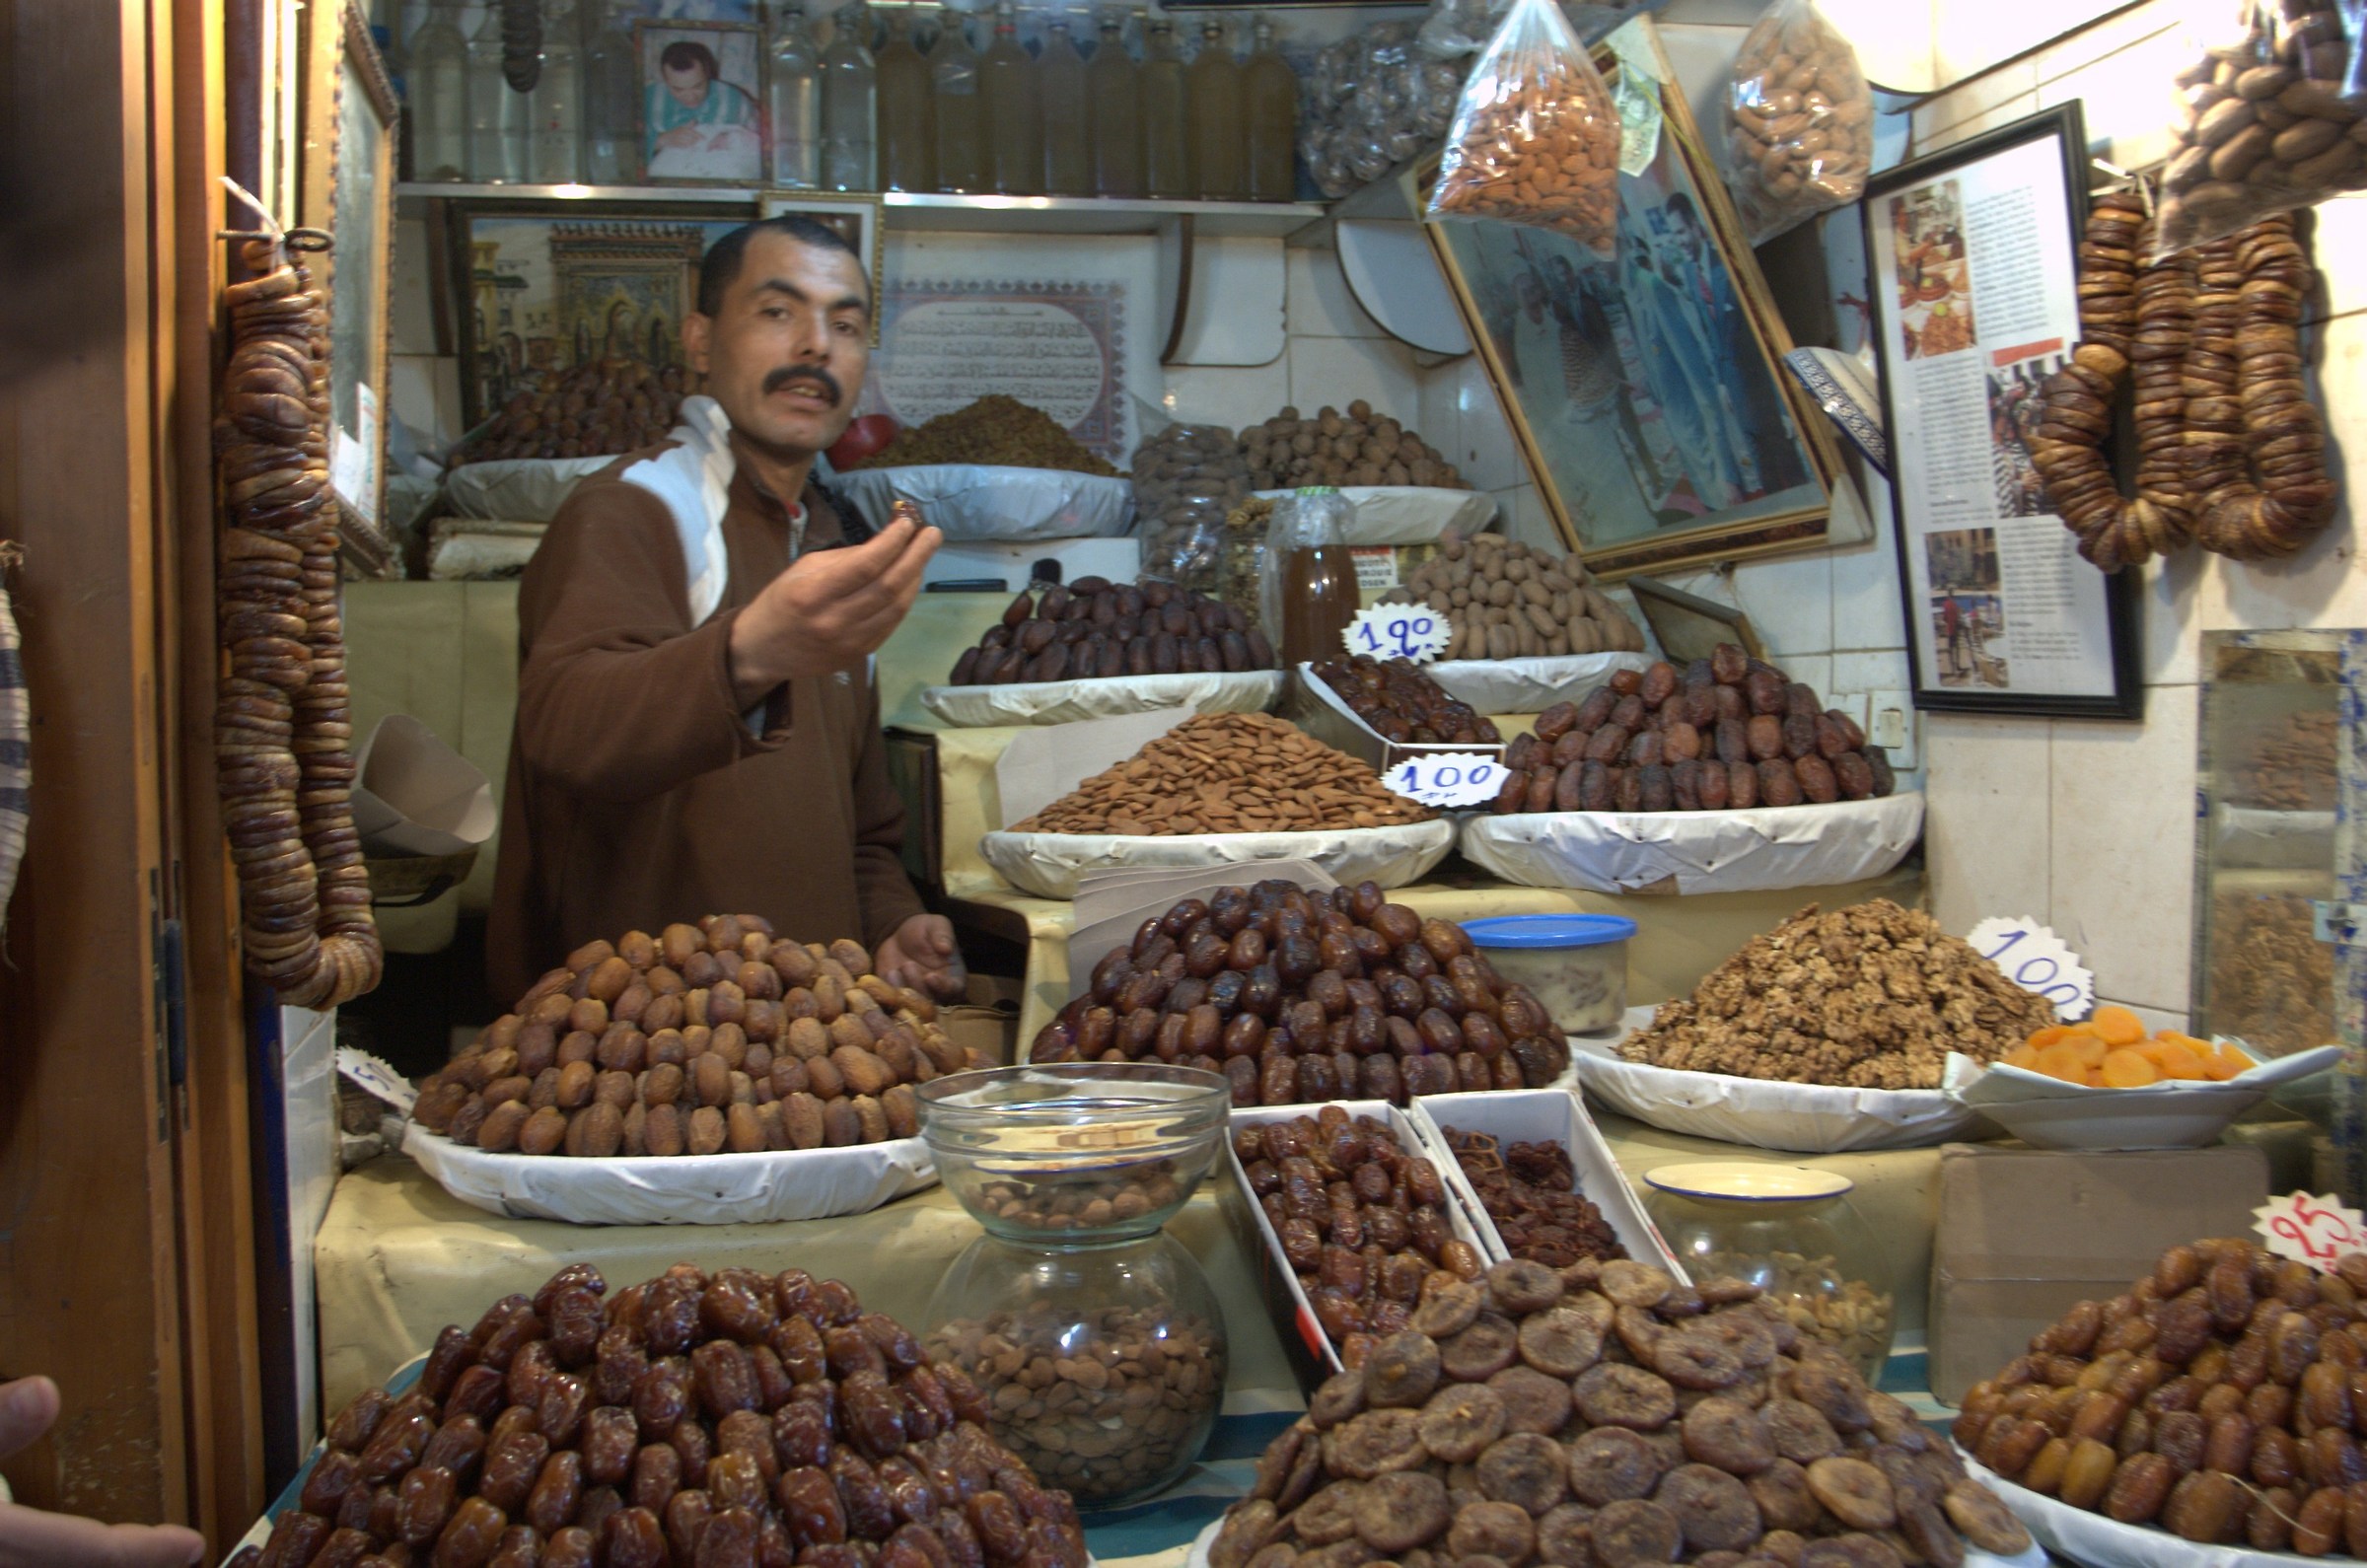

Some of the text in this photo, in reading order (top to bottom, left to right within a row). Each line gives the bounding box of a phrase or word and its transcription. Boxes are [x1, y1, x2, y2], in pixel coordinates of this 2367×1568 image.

[1358, 617, 1434, 656] 190
[1399, 765, 1492, 792] 100
[1983, 930, 2081, 1006] 100
[2270, 1195, 2358, 1258] 95
